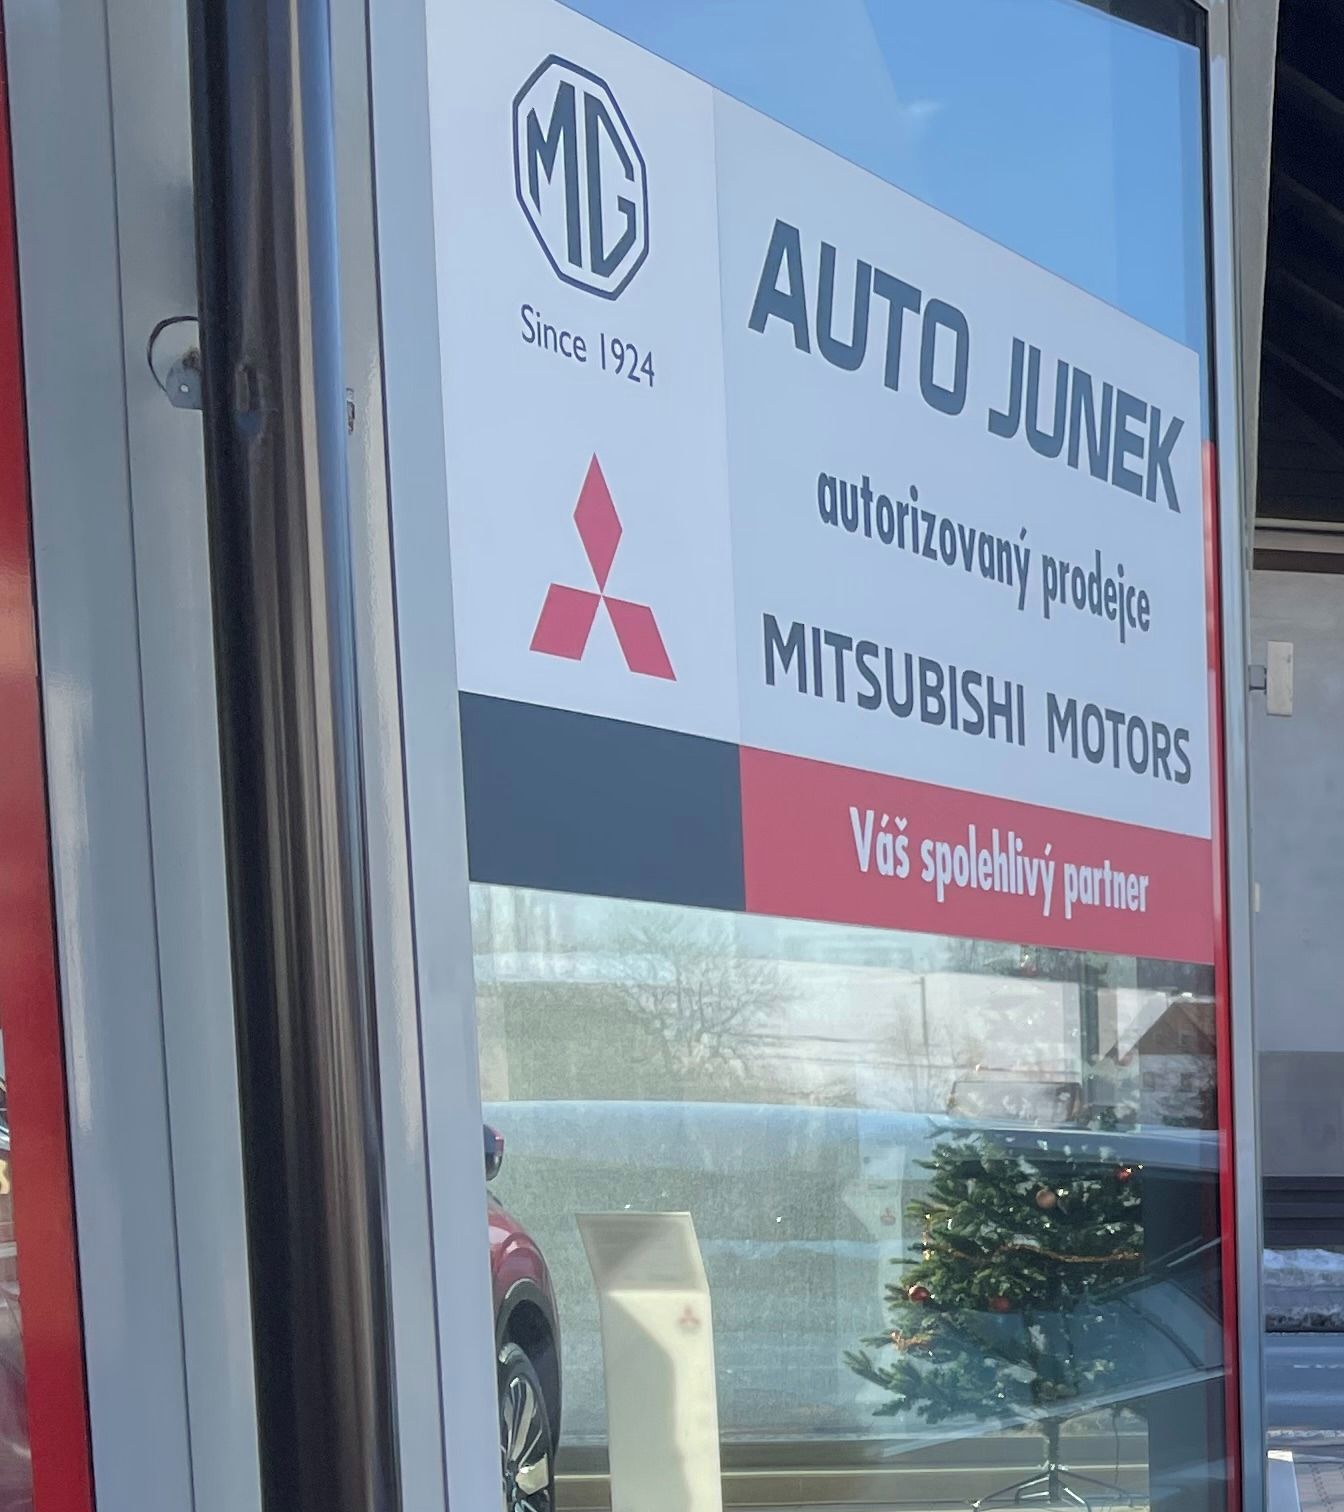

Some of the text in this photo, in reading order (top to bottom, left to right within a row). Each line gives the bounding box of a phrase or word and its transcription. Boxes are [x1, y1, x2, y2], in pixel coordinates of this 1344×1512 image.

[525, 79, 638, 277] MG
[520, 304, 655, 388] Since 1924
[748, 219, 1186, 514] AUTO JUNEK
[818, 471, 1151, 643] autorizovaný prodejce
[763, 613, 1192, 785] MITSUBISHI MOTORS
[850, 807, 1150, 917] Váš spolehlivý partner
